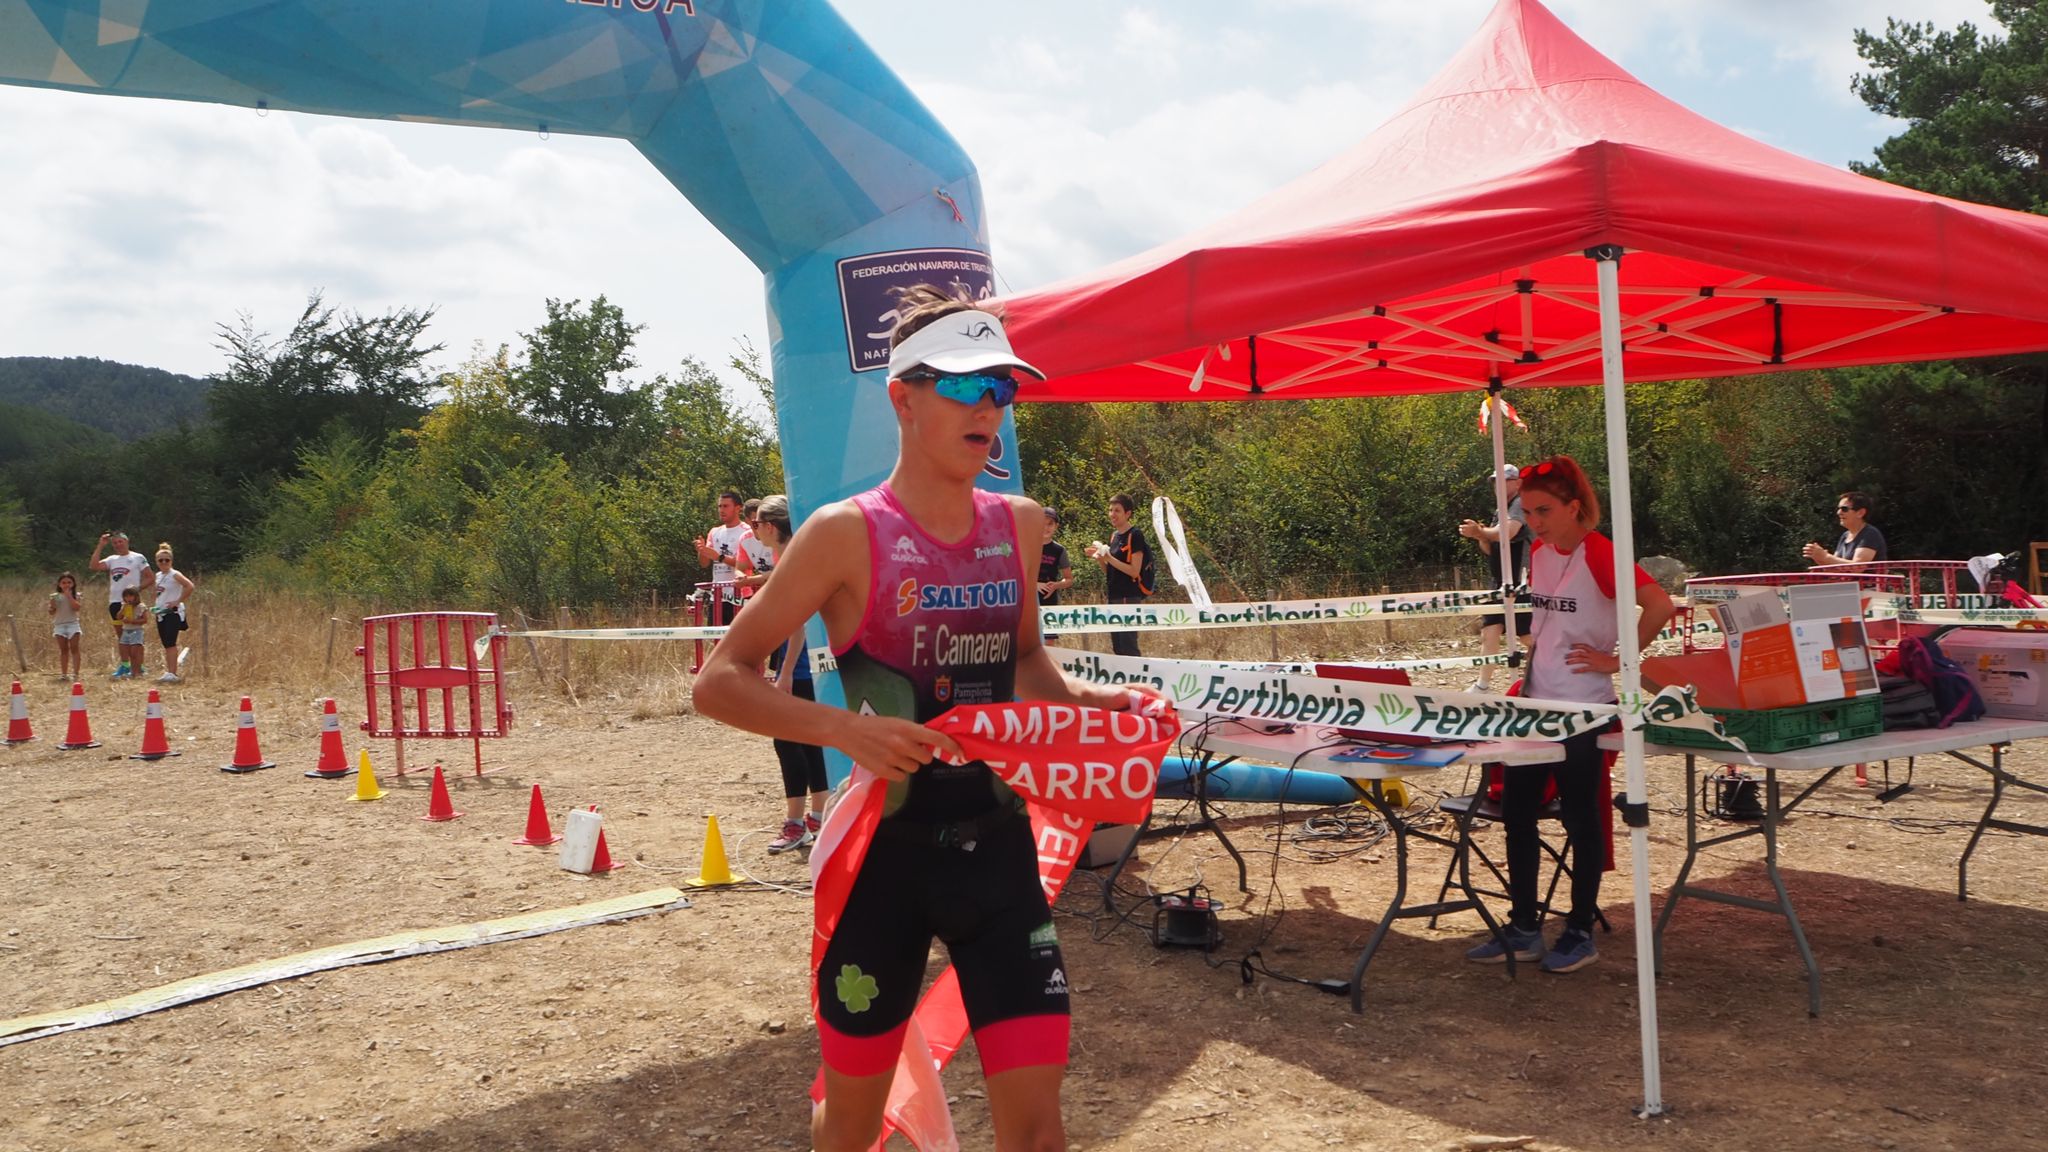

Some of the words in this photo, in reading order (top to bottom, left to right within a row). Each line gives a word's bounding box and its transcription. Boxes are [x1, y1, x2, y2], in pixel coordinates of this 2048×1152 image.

[852, 260, 917, 279] FEDERACIÓN
[918, 260, 959, 272] NAVARRA
[960, 262, 971, 271] DE
[863, 347, 893, 361] NAF
[920, 579, 1017, 611] SALTOKI
[1041, 607, 1159, 625] ertiberia
[1381, 590, 1503, 614] Fertiber
[912, 625, 928, 667] F.
[935, 624, 1011, 666] Camarero
[1196, 675, 1365, 728] Fertiberia
[948, 705, 1160, 744] AMPEO
